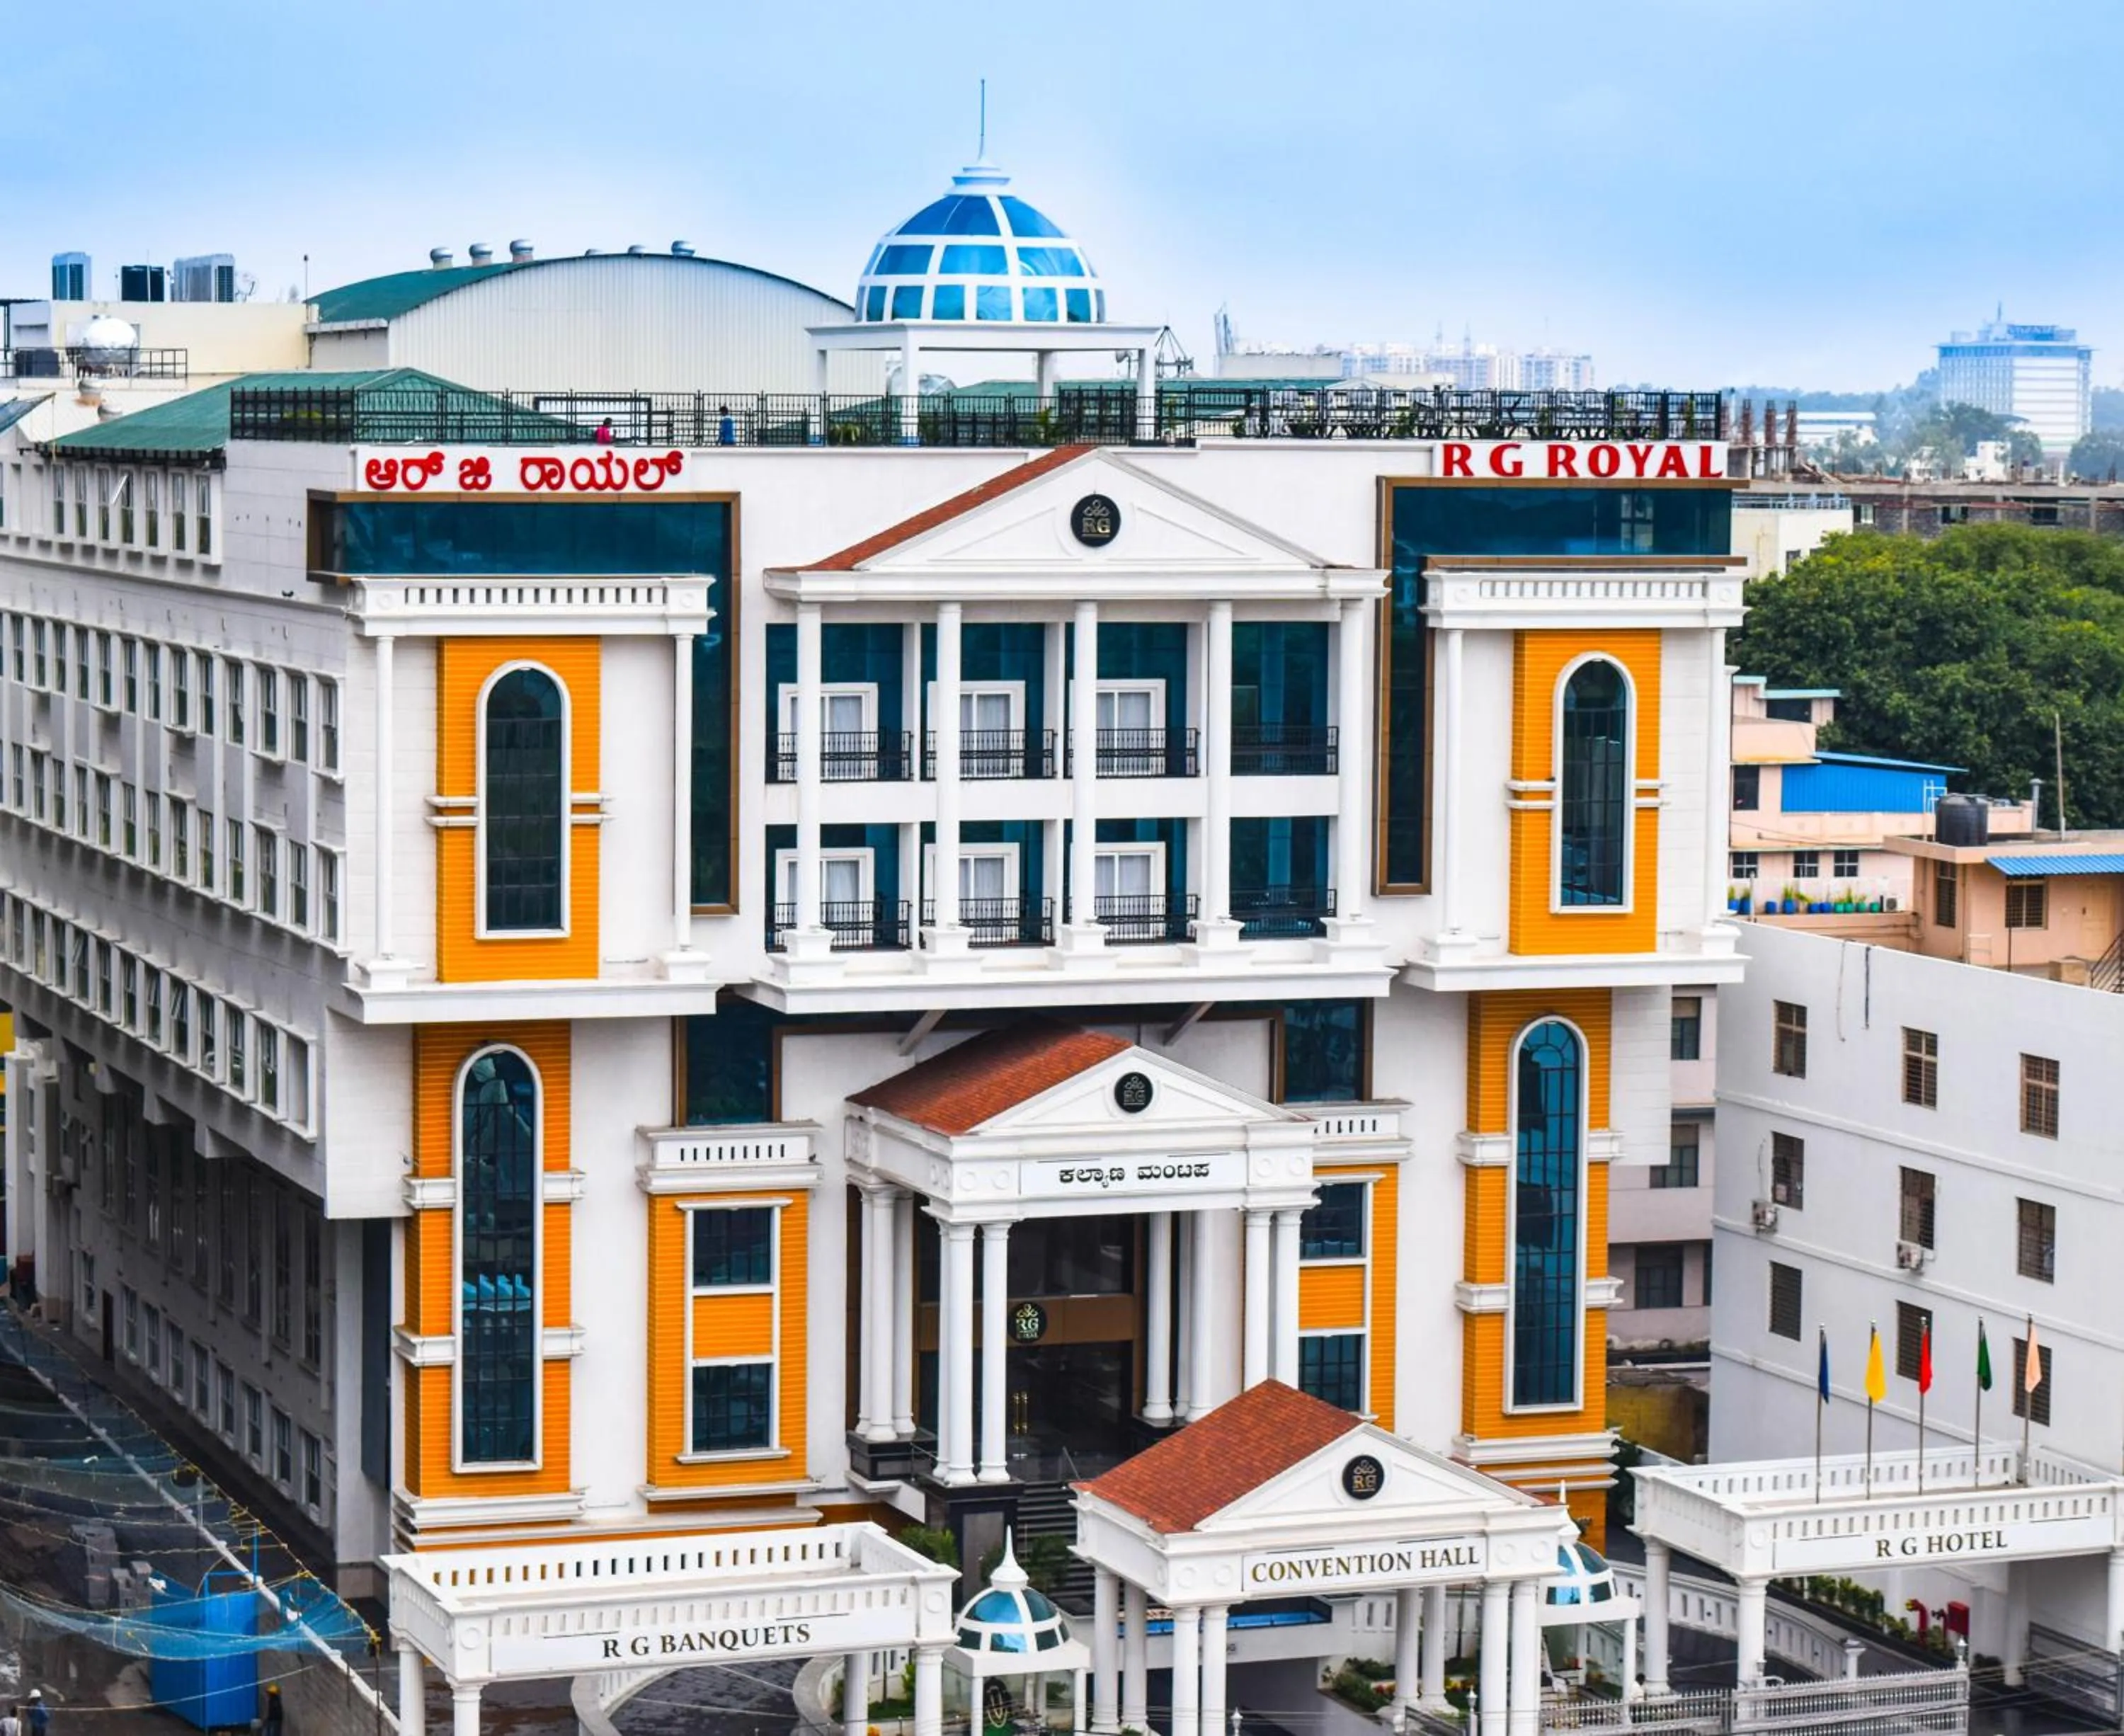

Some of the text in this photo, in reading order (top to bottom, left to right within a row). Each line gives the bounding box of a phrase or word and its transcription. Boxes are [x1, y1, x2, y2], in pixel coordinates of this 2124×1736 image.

[365, 451, 445, 491] ಆರ್
[520, 450, 685, 491] ರಾಯಲ್
[1442, 443, 1723, 478] R G ROYAL
[1082, 518, 1111, 533] RG
[1059, 1162, 1211, 1188] ಕಲ್ಯಾಣ ಮಂಟಪ
[1876, 1530, 2008, 1558] R G HOTEL
[1252, 1546, 1479, 1583] CONVENTION HALL
[603, 1623, 811, 1658] R G BANQUETS
